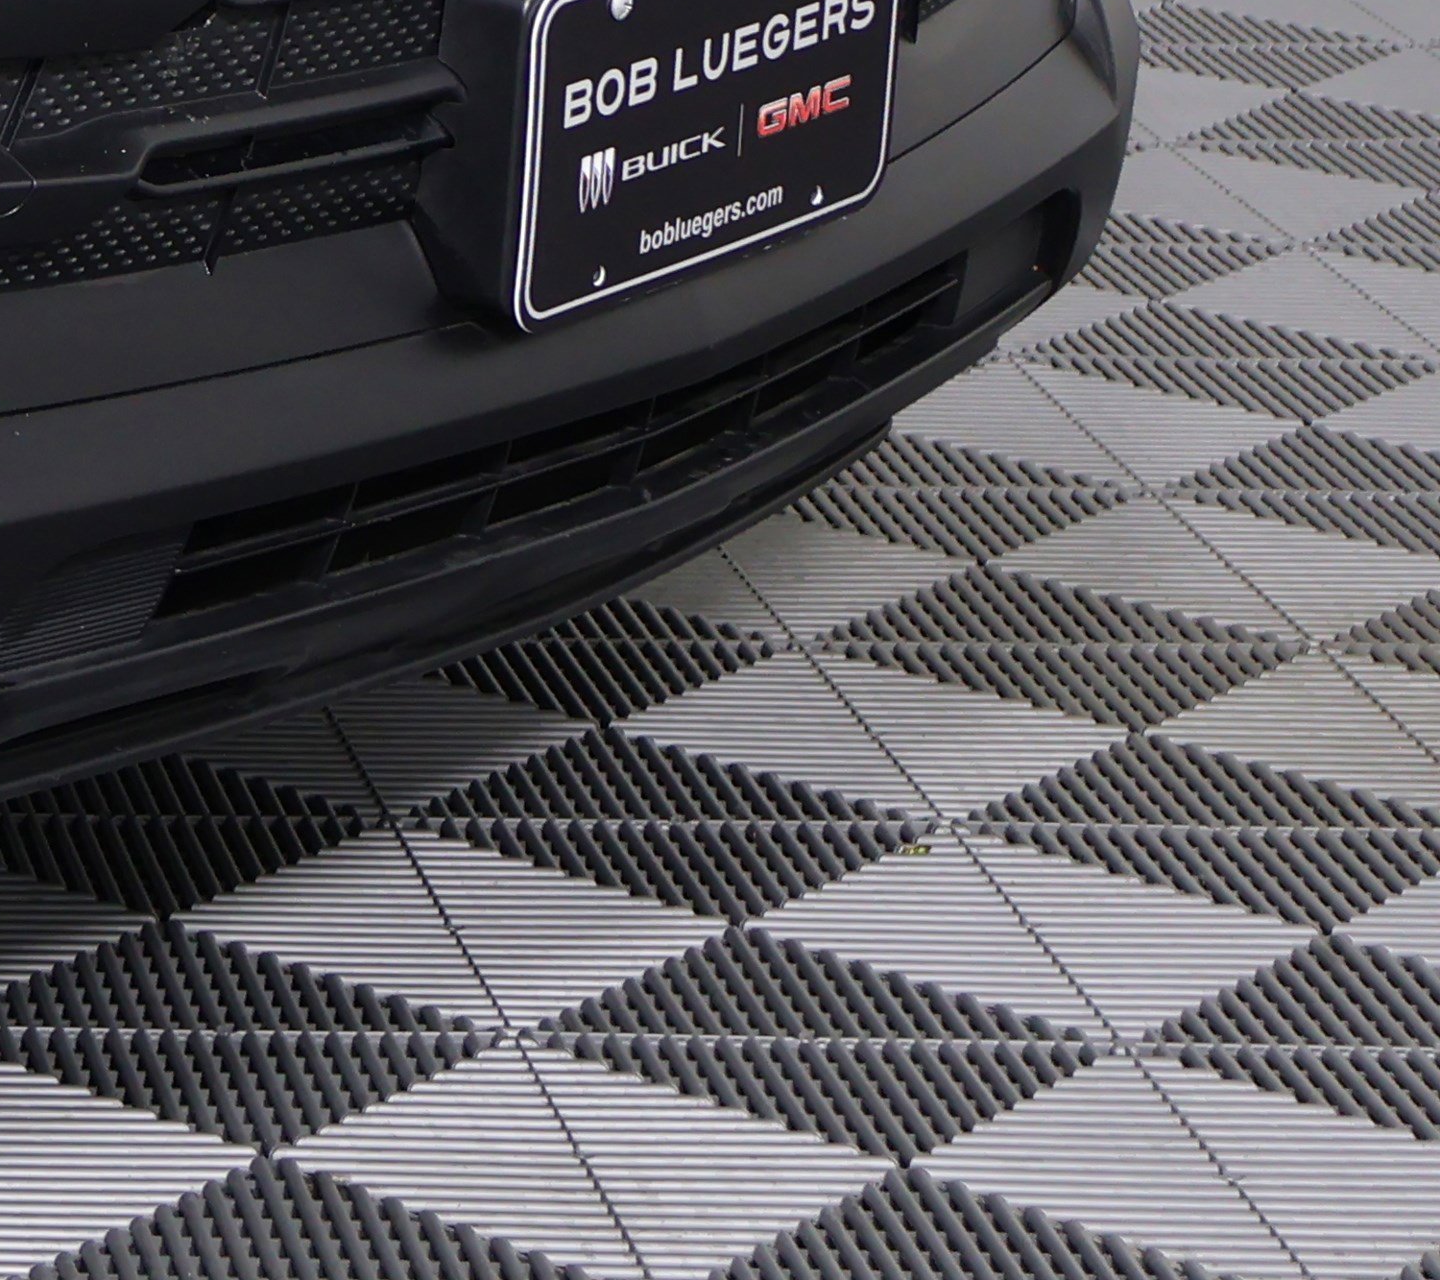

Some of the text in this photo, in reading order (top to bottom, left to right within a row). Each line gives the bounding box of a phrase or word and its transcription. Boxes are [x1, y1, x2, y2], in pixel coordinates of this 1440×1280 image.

[563, 57, 659, 130] BOB
[756, 74, 852, 139] GMC
[621, 125, 726, 182] BUICK
[639, 185, 784, 255] bobluegers.com
